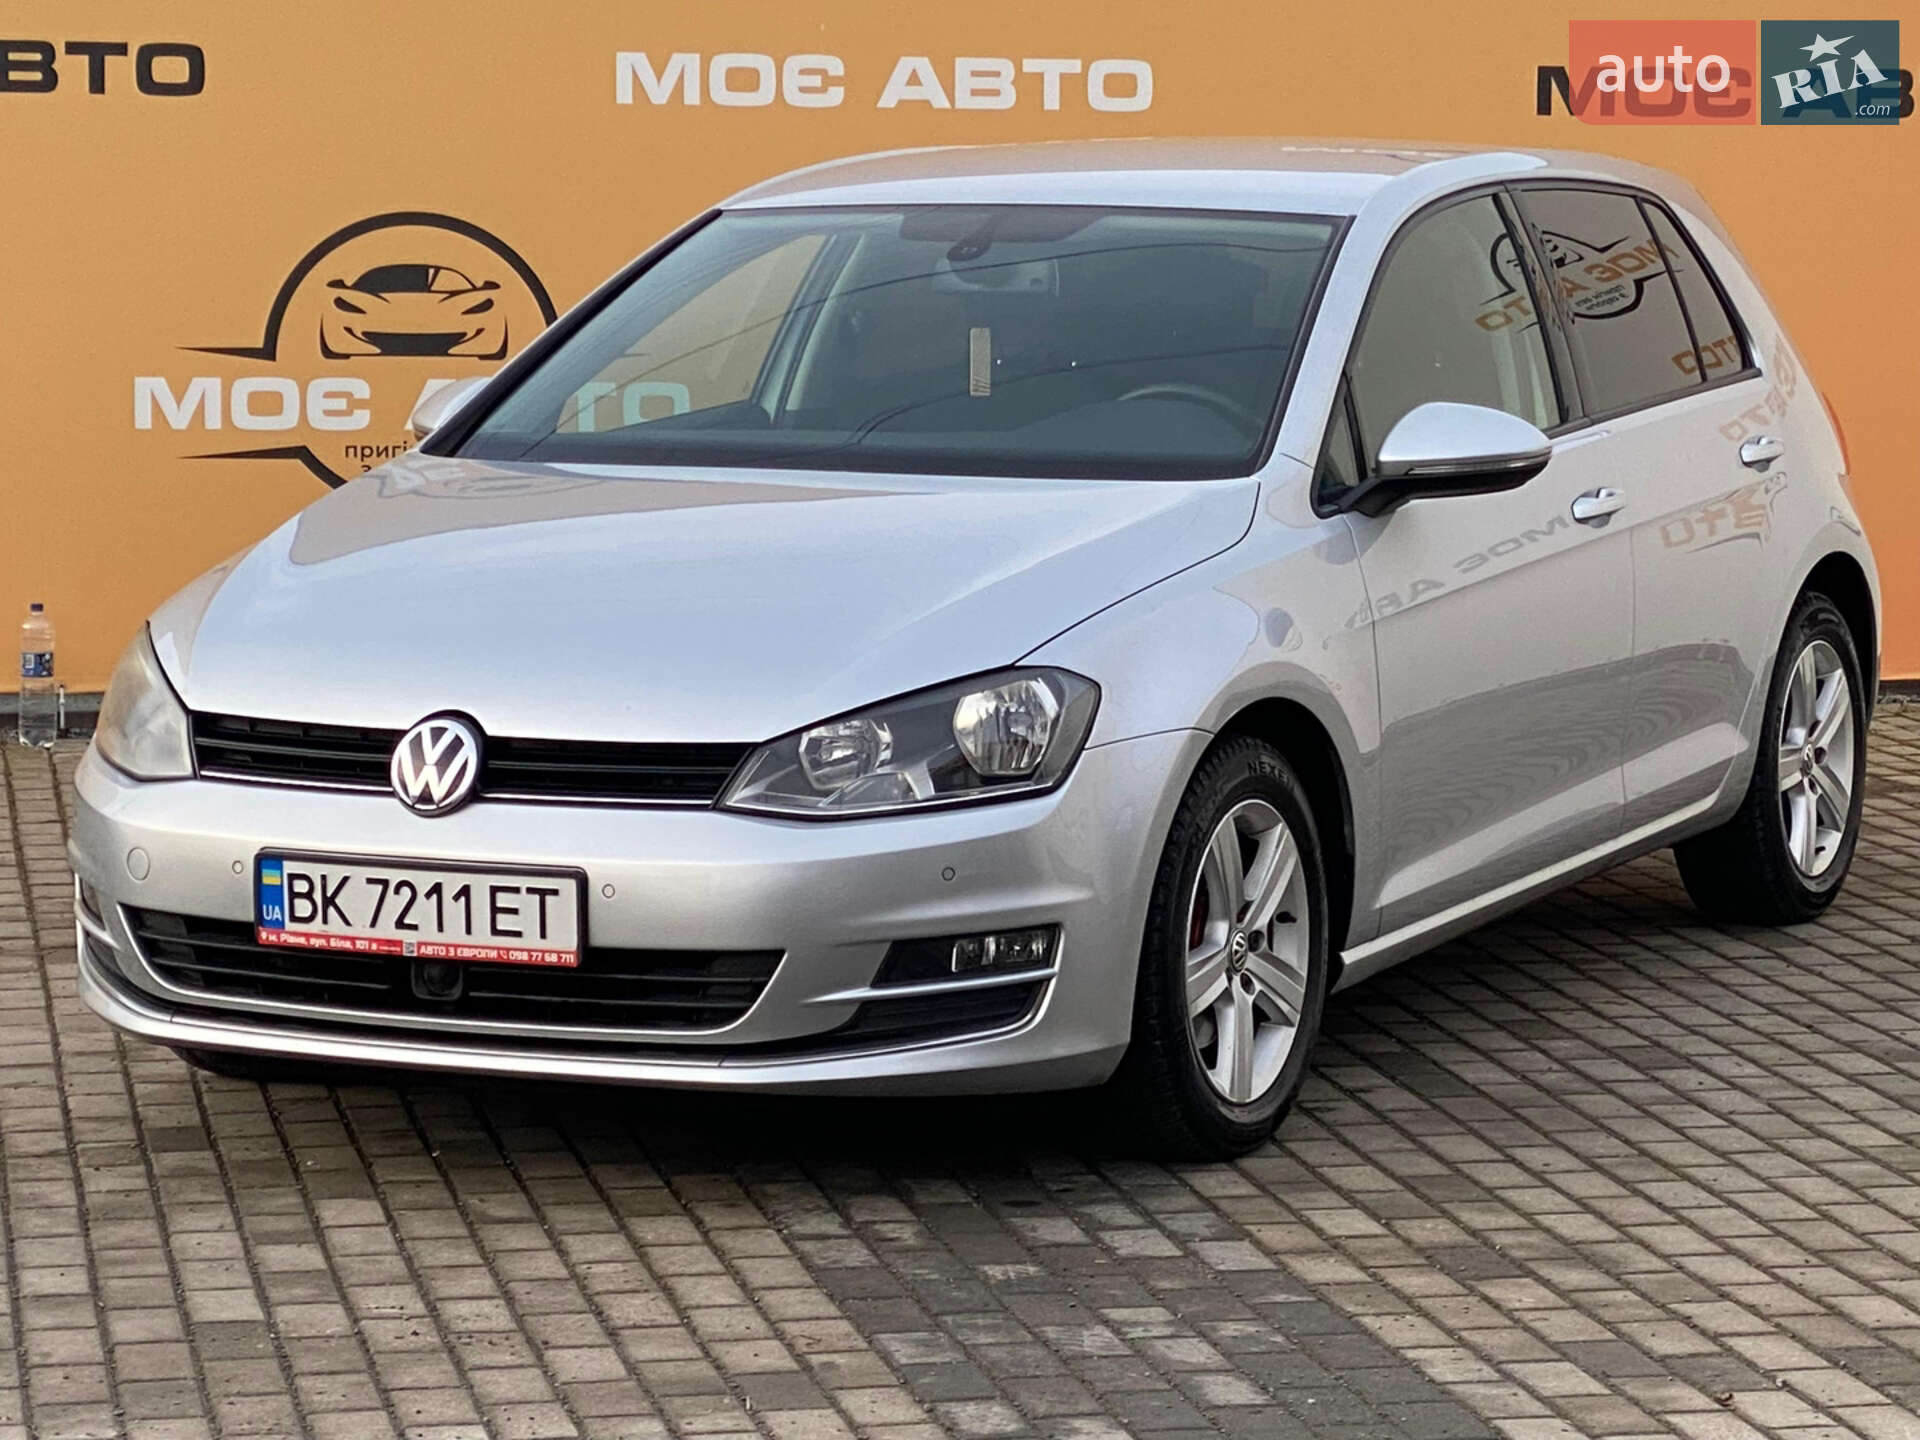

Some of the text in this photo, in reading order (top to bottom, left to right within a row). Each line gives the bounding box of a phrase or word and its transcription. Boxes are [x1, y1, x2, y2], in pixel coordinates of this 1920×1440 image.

[615, 51, 1153, 112] МОЄ АВТО
[134, 376, 371, 431] МОЄ
[345, 440, 409, 462] пригі
[263, 904, 282, 922] UA
[287, 872, 559, 940] BK 7211 ET
[420, 944, 446, 956] АВТО
